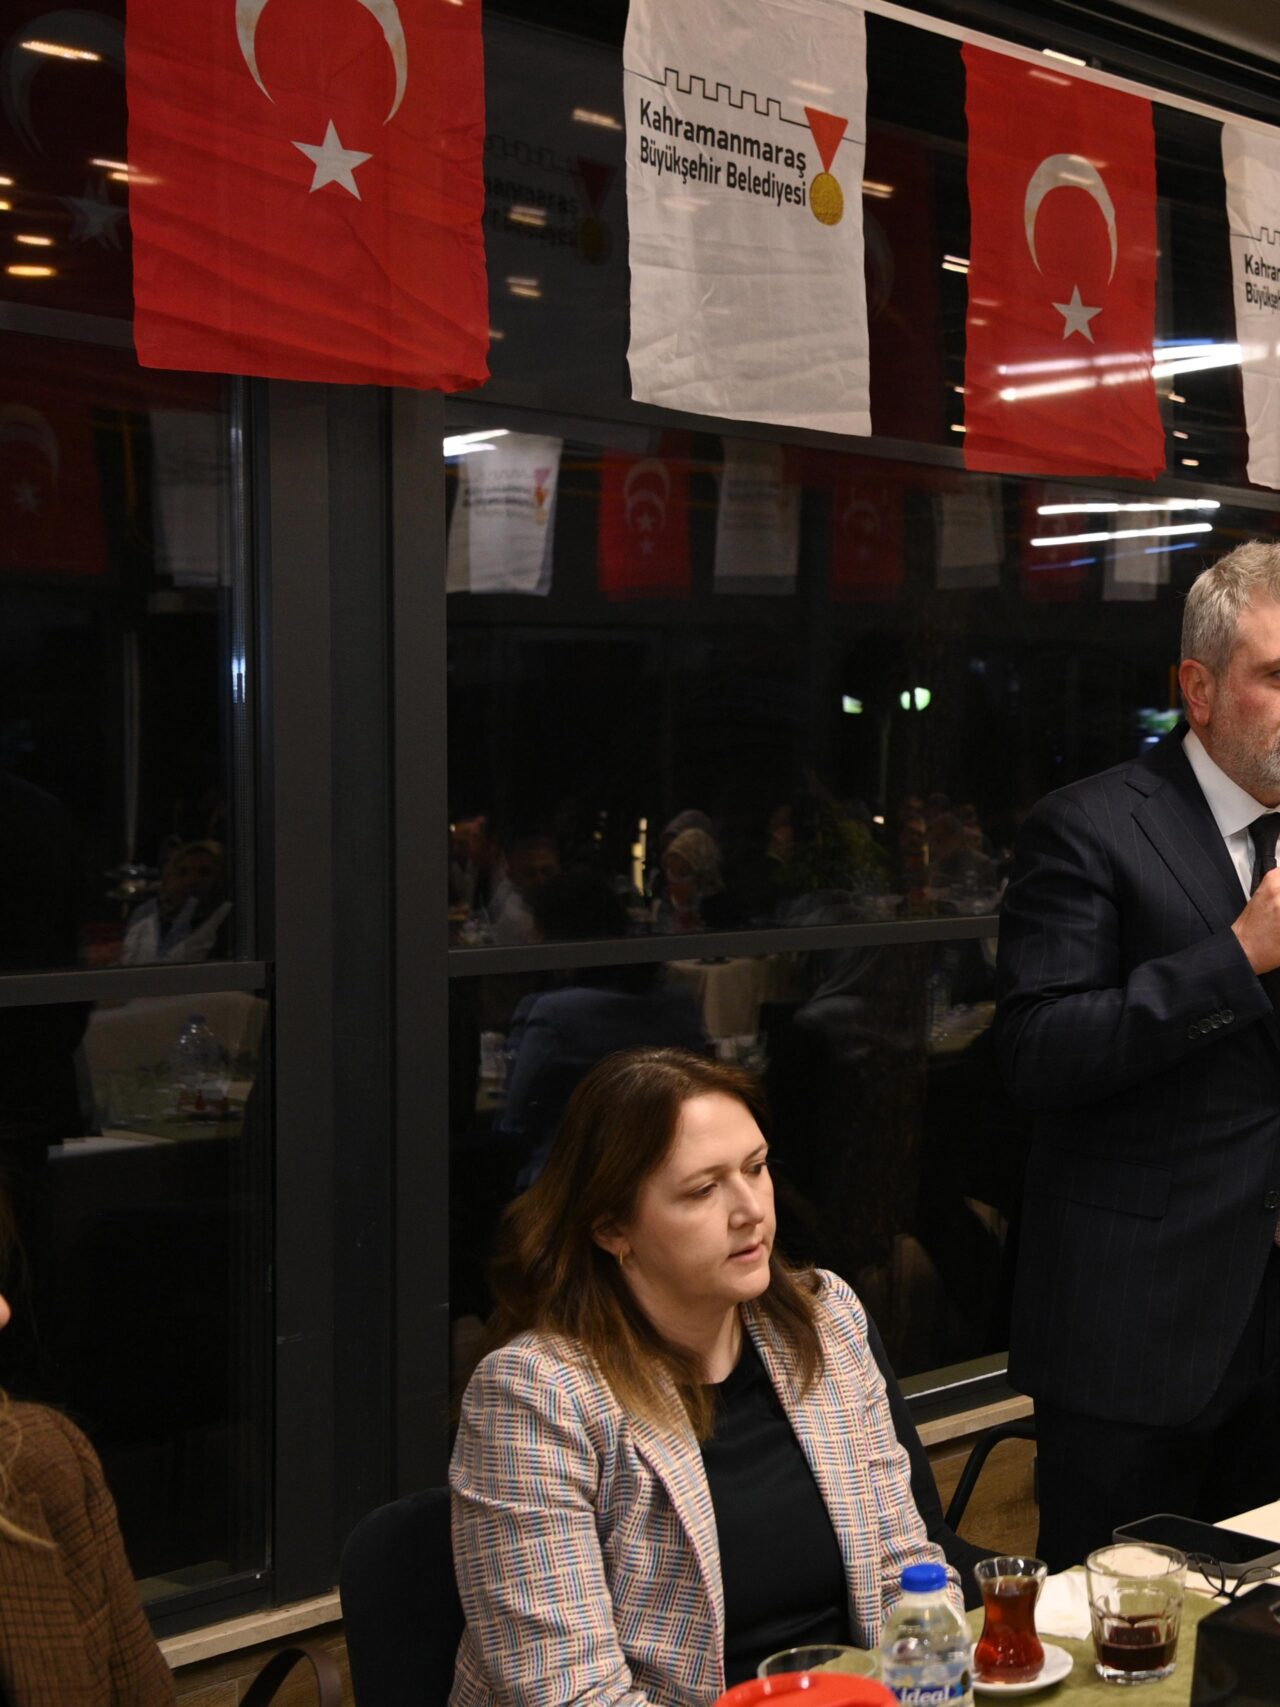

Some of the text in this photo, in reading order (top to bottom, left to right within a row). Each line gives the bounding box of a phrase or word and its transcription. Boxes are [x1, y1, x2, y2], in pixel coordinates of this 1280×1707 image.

[640, 98, 807, 177] Kahramanmaraş
[640, 136, 807, 207] Büyükşehir Belediyesi
